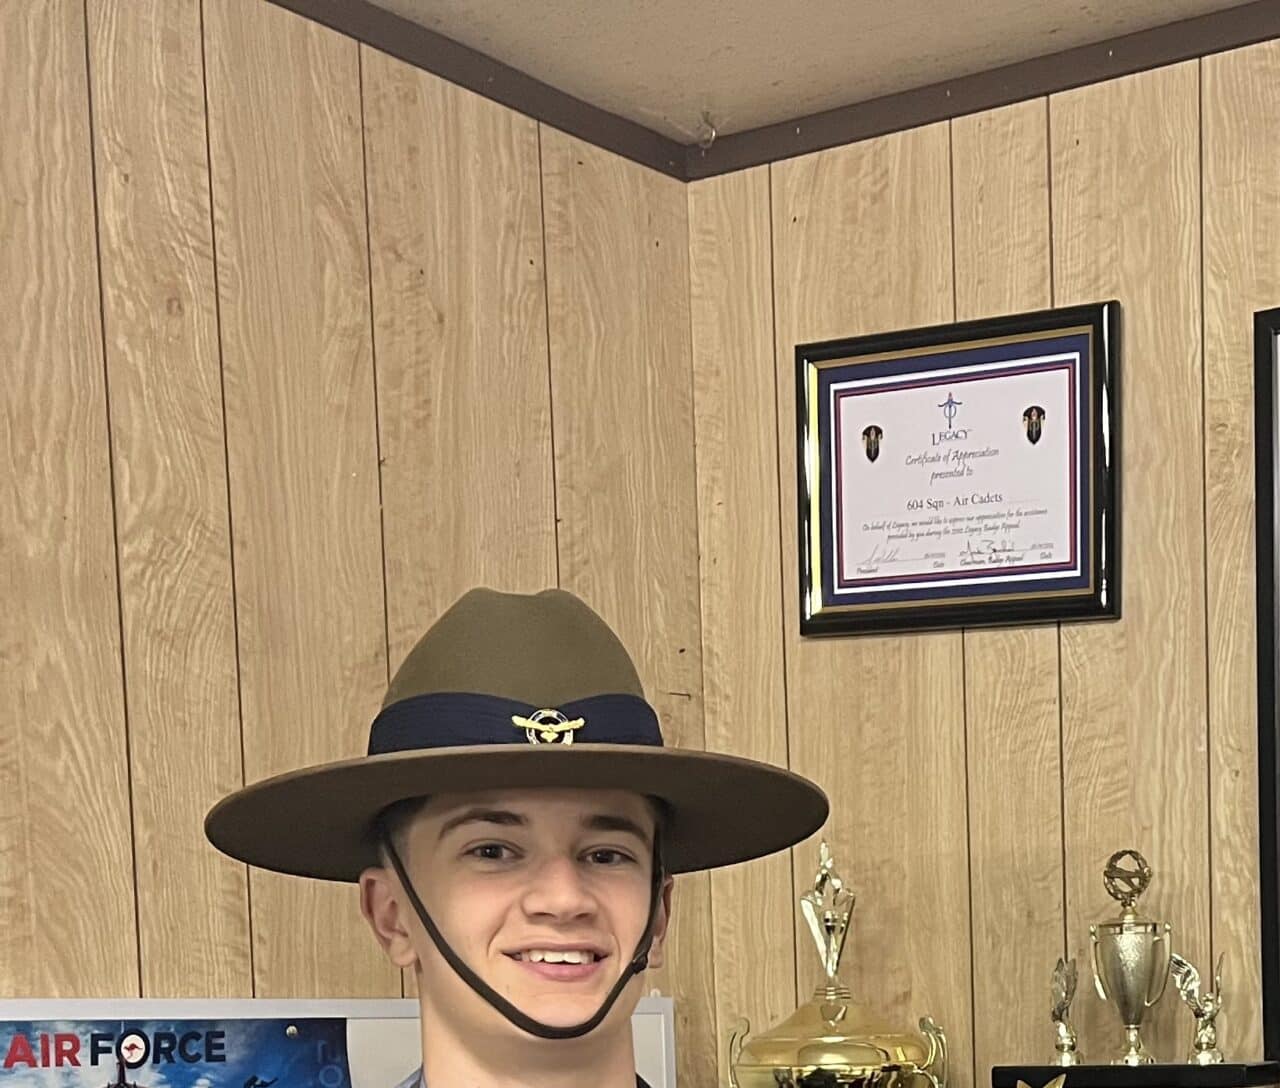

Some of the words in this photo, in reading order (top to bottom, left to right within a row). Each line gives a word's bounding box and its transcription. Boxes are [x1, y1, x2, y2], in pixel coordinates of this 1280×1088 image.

[931, 428, 969, 447] LEGACY
[905, 451, 941, 467] Certificate
[951, 447, 999, 466] Appreciation
[906, 500, 924, 511] 604
[925, 498, 945, 512] Sqn
[953, 496, 969, 507] Air
[970, 492, 1003, 505] Cadets
[2, 1033, 82, 1069] AIR
[90, 1028, 227, 1070] FORCE
